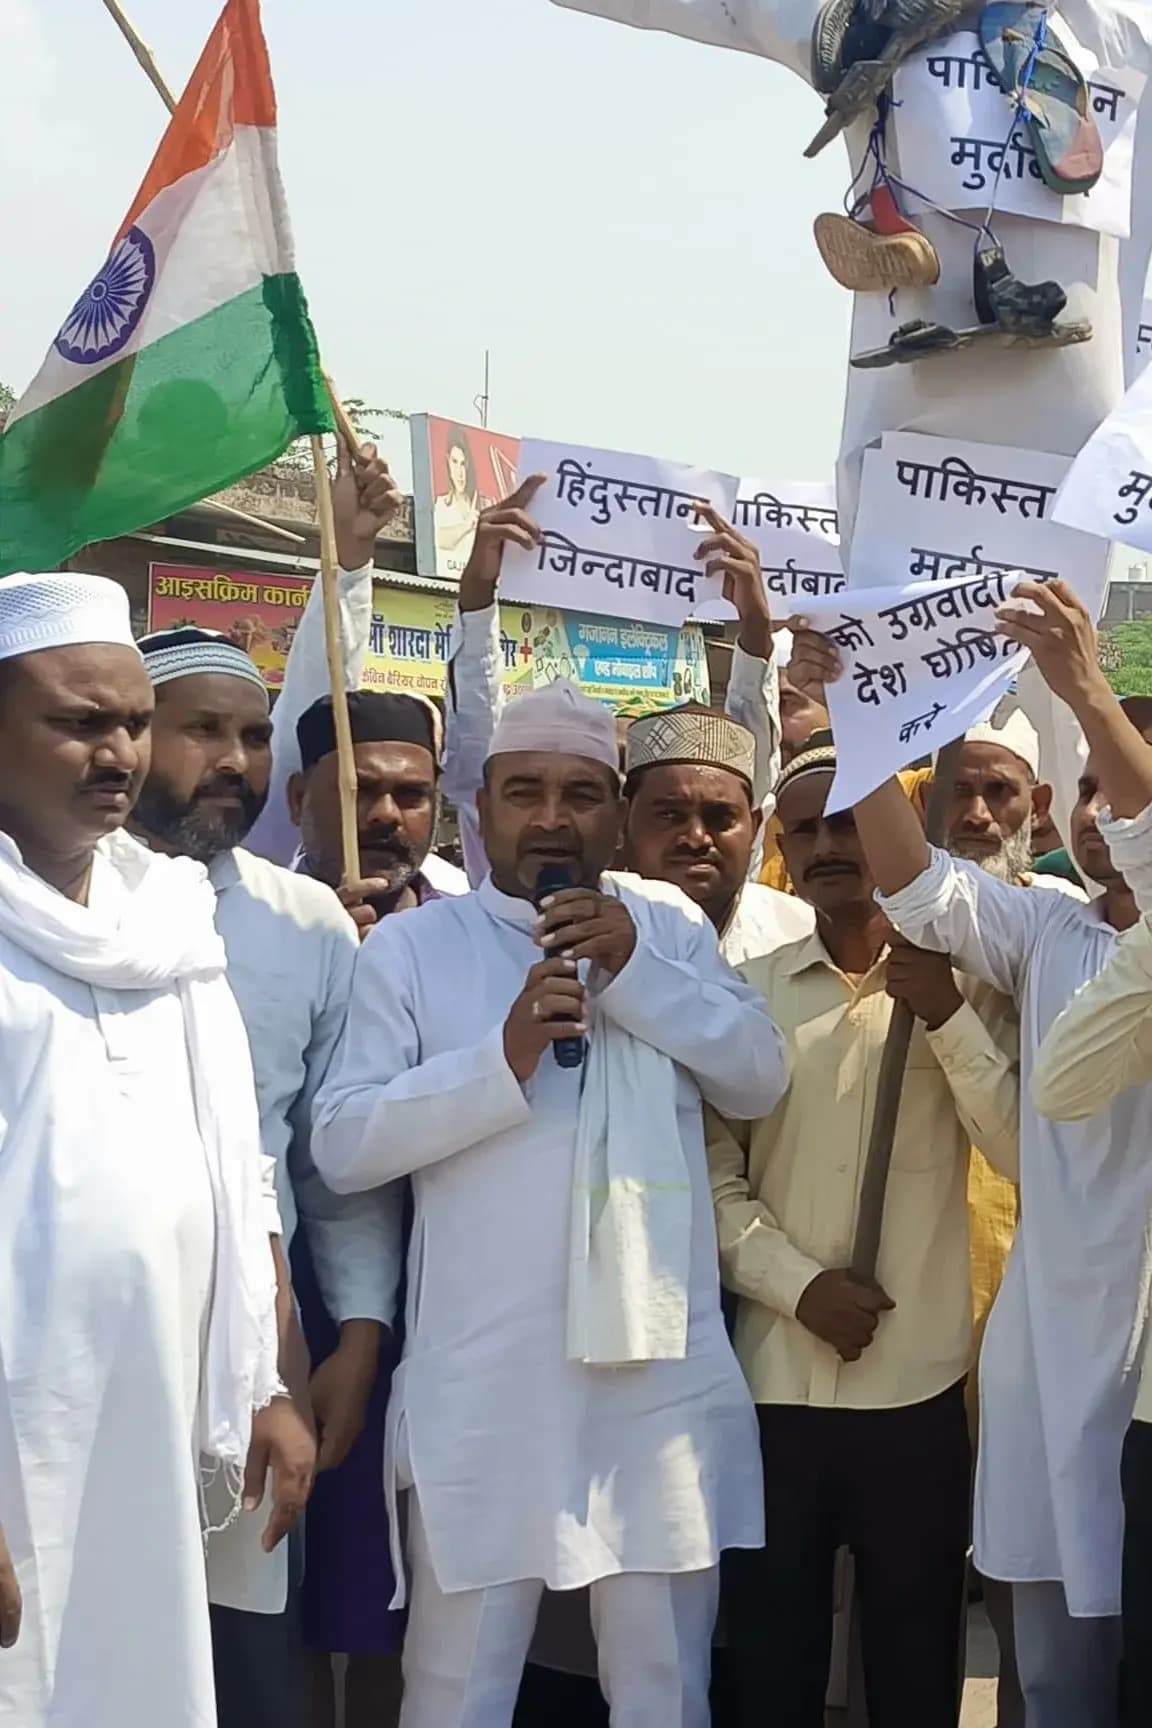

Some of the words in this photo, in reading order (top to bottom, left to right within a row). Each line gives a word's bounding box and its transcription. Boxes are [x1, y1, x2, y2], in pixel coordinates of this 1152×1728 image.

[556, 459, 711, 524] हिंदुस्तान
[896, 457, 1057, 519] पाकिस्त
[537, 530, 704, 601] जिन्दाबाद
[263, 584, 312, 607] कार्न
[388, 625, 432, 660] शारदा
[823, 614, 875, 651] को
[852, 662, 908, 706] देश
[899, 702, 946, 744] करे
